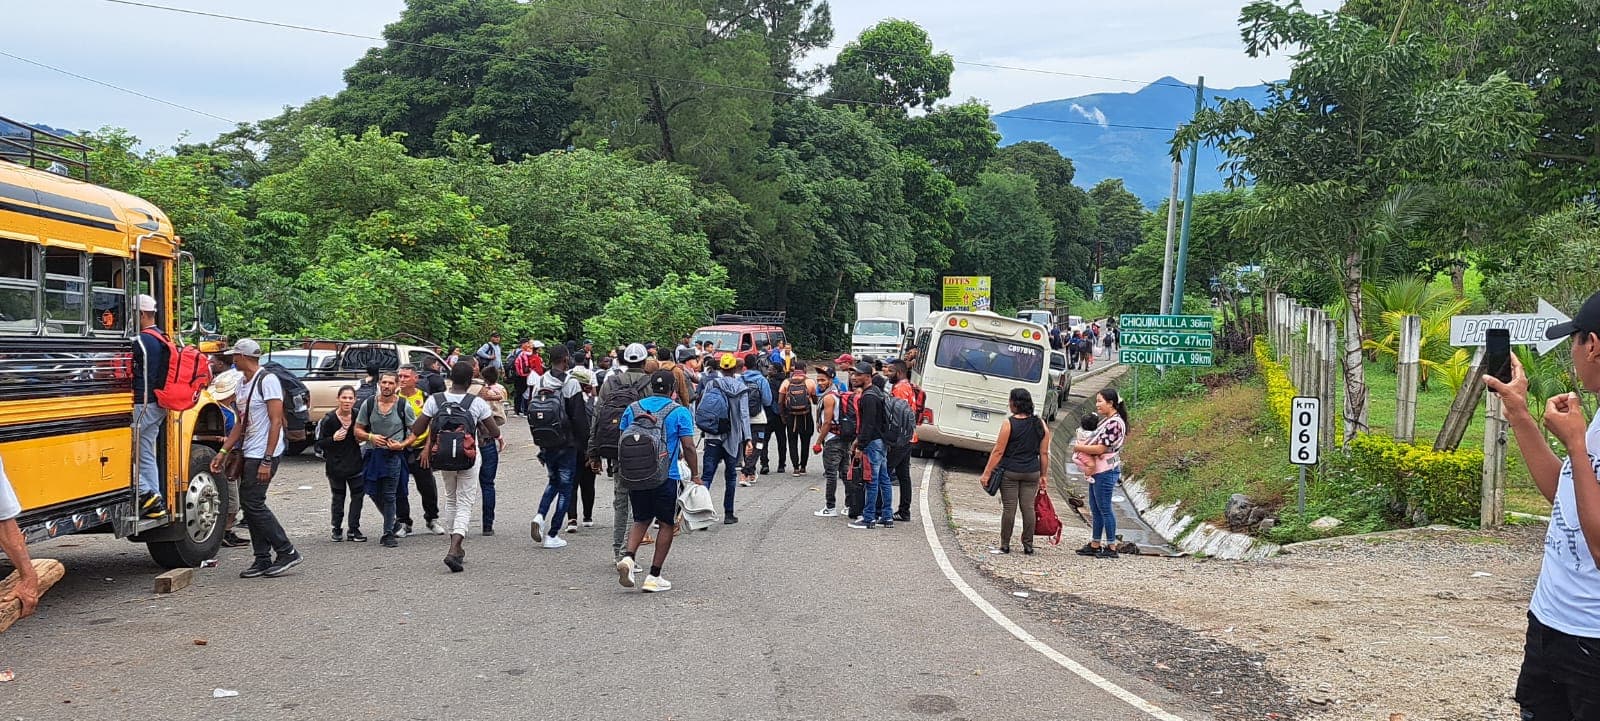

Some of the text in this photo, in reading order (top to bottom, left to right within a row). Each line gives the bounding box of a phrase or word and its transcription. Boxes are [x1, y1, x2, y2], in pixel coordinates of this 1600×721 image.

[1122, 317, 1212, 328] CHIQUIMULILLA 36km
[1122, 333, 1211, 347] TAXISCO 47km
[1122, 351, 1211, 364] ESCUINTLA 99km
[1296, 401, 1315, 409] km
[1298, 411, 1312, 461] 066
